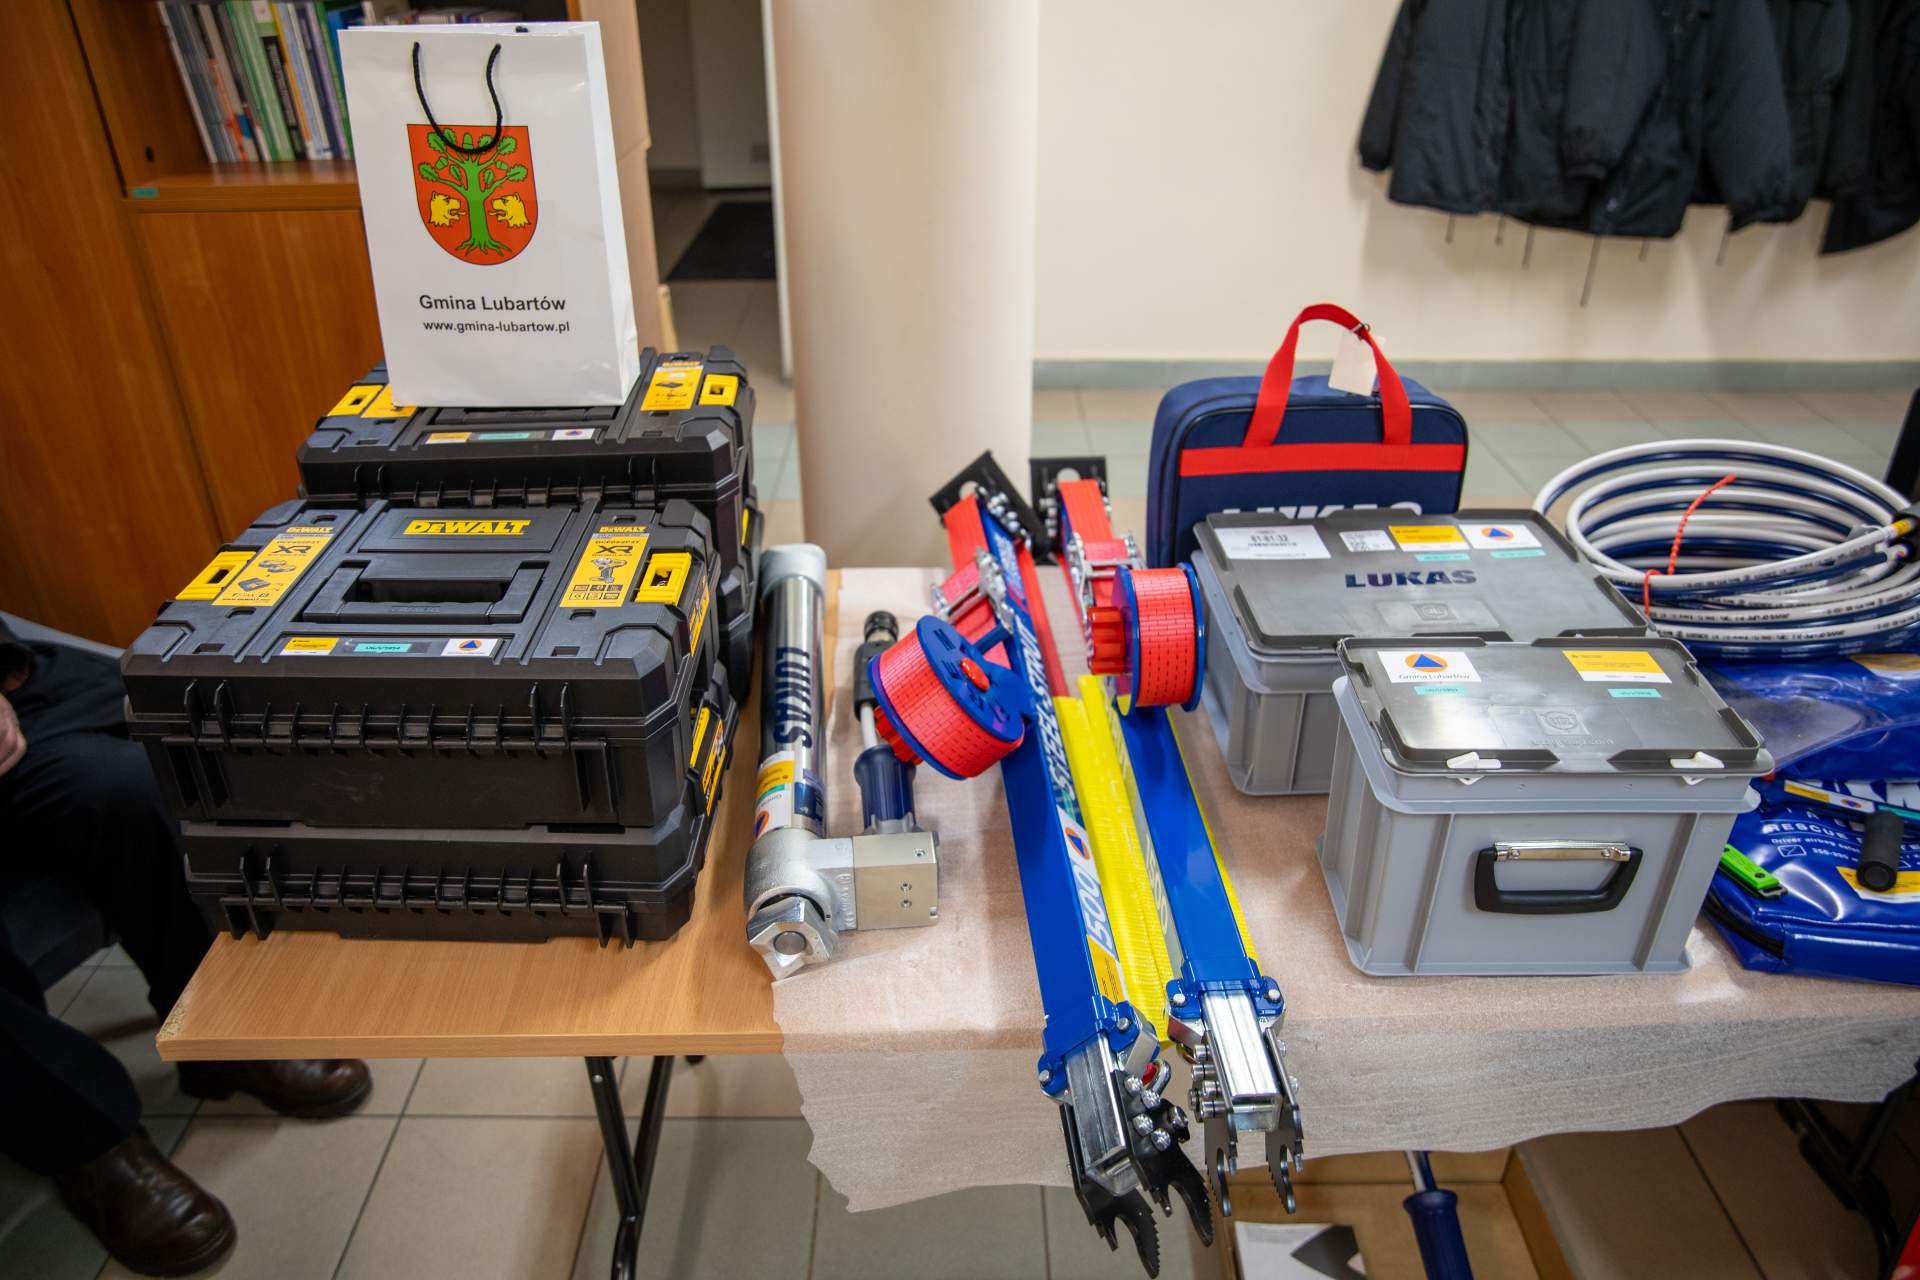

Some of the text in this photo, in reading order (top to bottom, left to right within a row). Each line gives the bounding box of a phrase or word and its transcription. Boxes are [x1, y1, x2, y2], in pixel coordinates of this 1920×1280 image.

[419, 294, 566, 311] Gmina Lubartów
[423, 320, 570, 334] www.gmina-lubartow.pl
[272, 545, 311, 554] XR
[595, 545, 634, 554] XR
[1345, 570, 1477, 589] LUKAS
[773, 646, 813, 749] LUKAS
[1762, 822, 1848, 840] RESCUE
